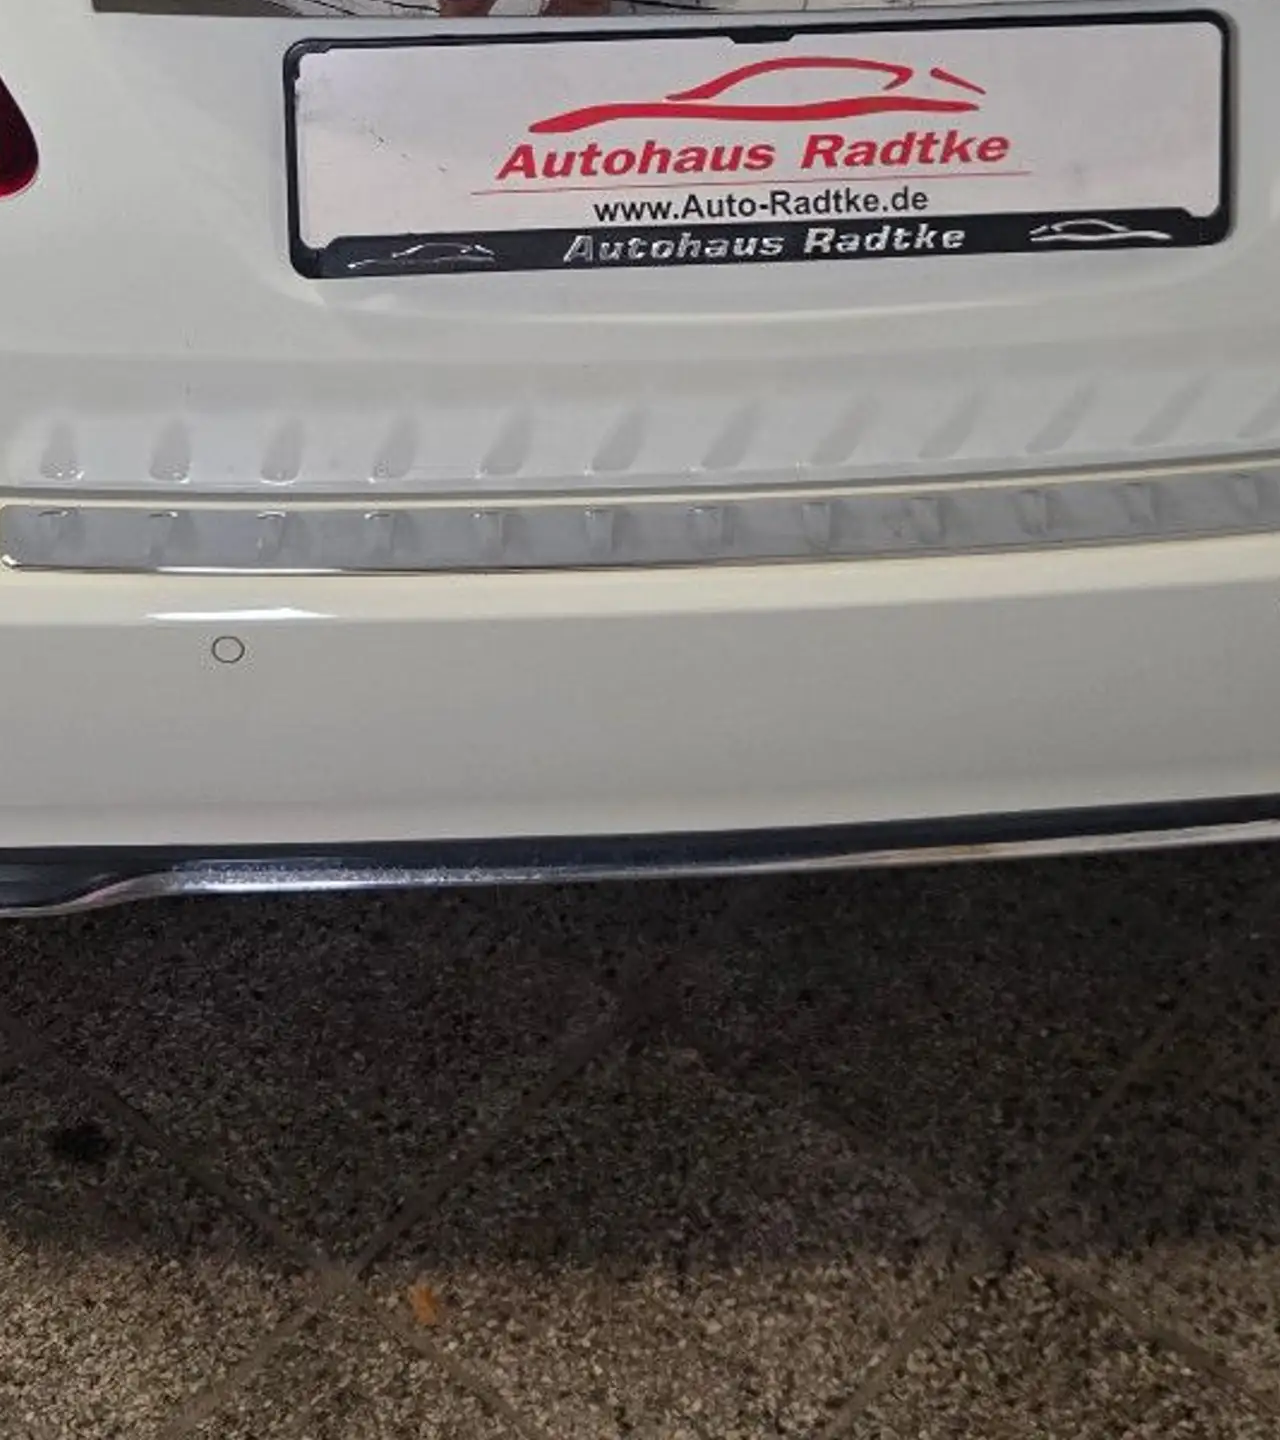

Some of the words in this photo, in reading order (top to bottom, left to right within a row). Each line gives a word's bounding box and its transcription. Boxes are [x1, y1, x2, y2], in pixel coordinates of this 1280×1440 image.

[495, 140, 775, 180] Autohaus
[800, 129, 1010, 169] Radtke
[593, 185, 929, 222] www.Auto-Radtke.de
[563, 231, 786, 263] Autohaus
[803, 222, 966, 255] Radtke
